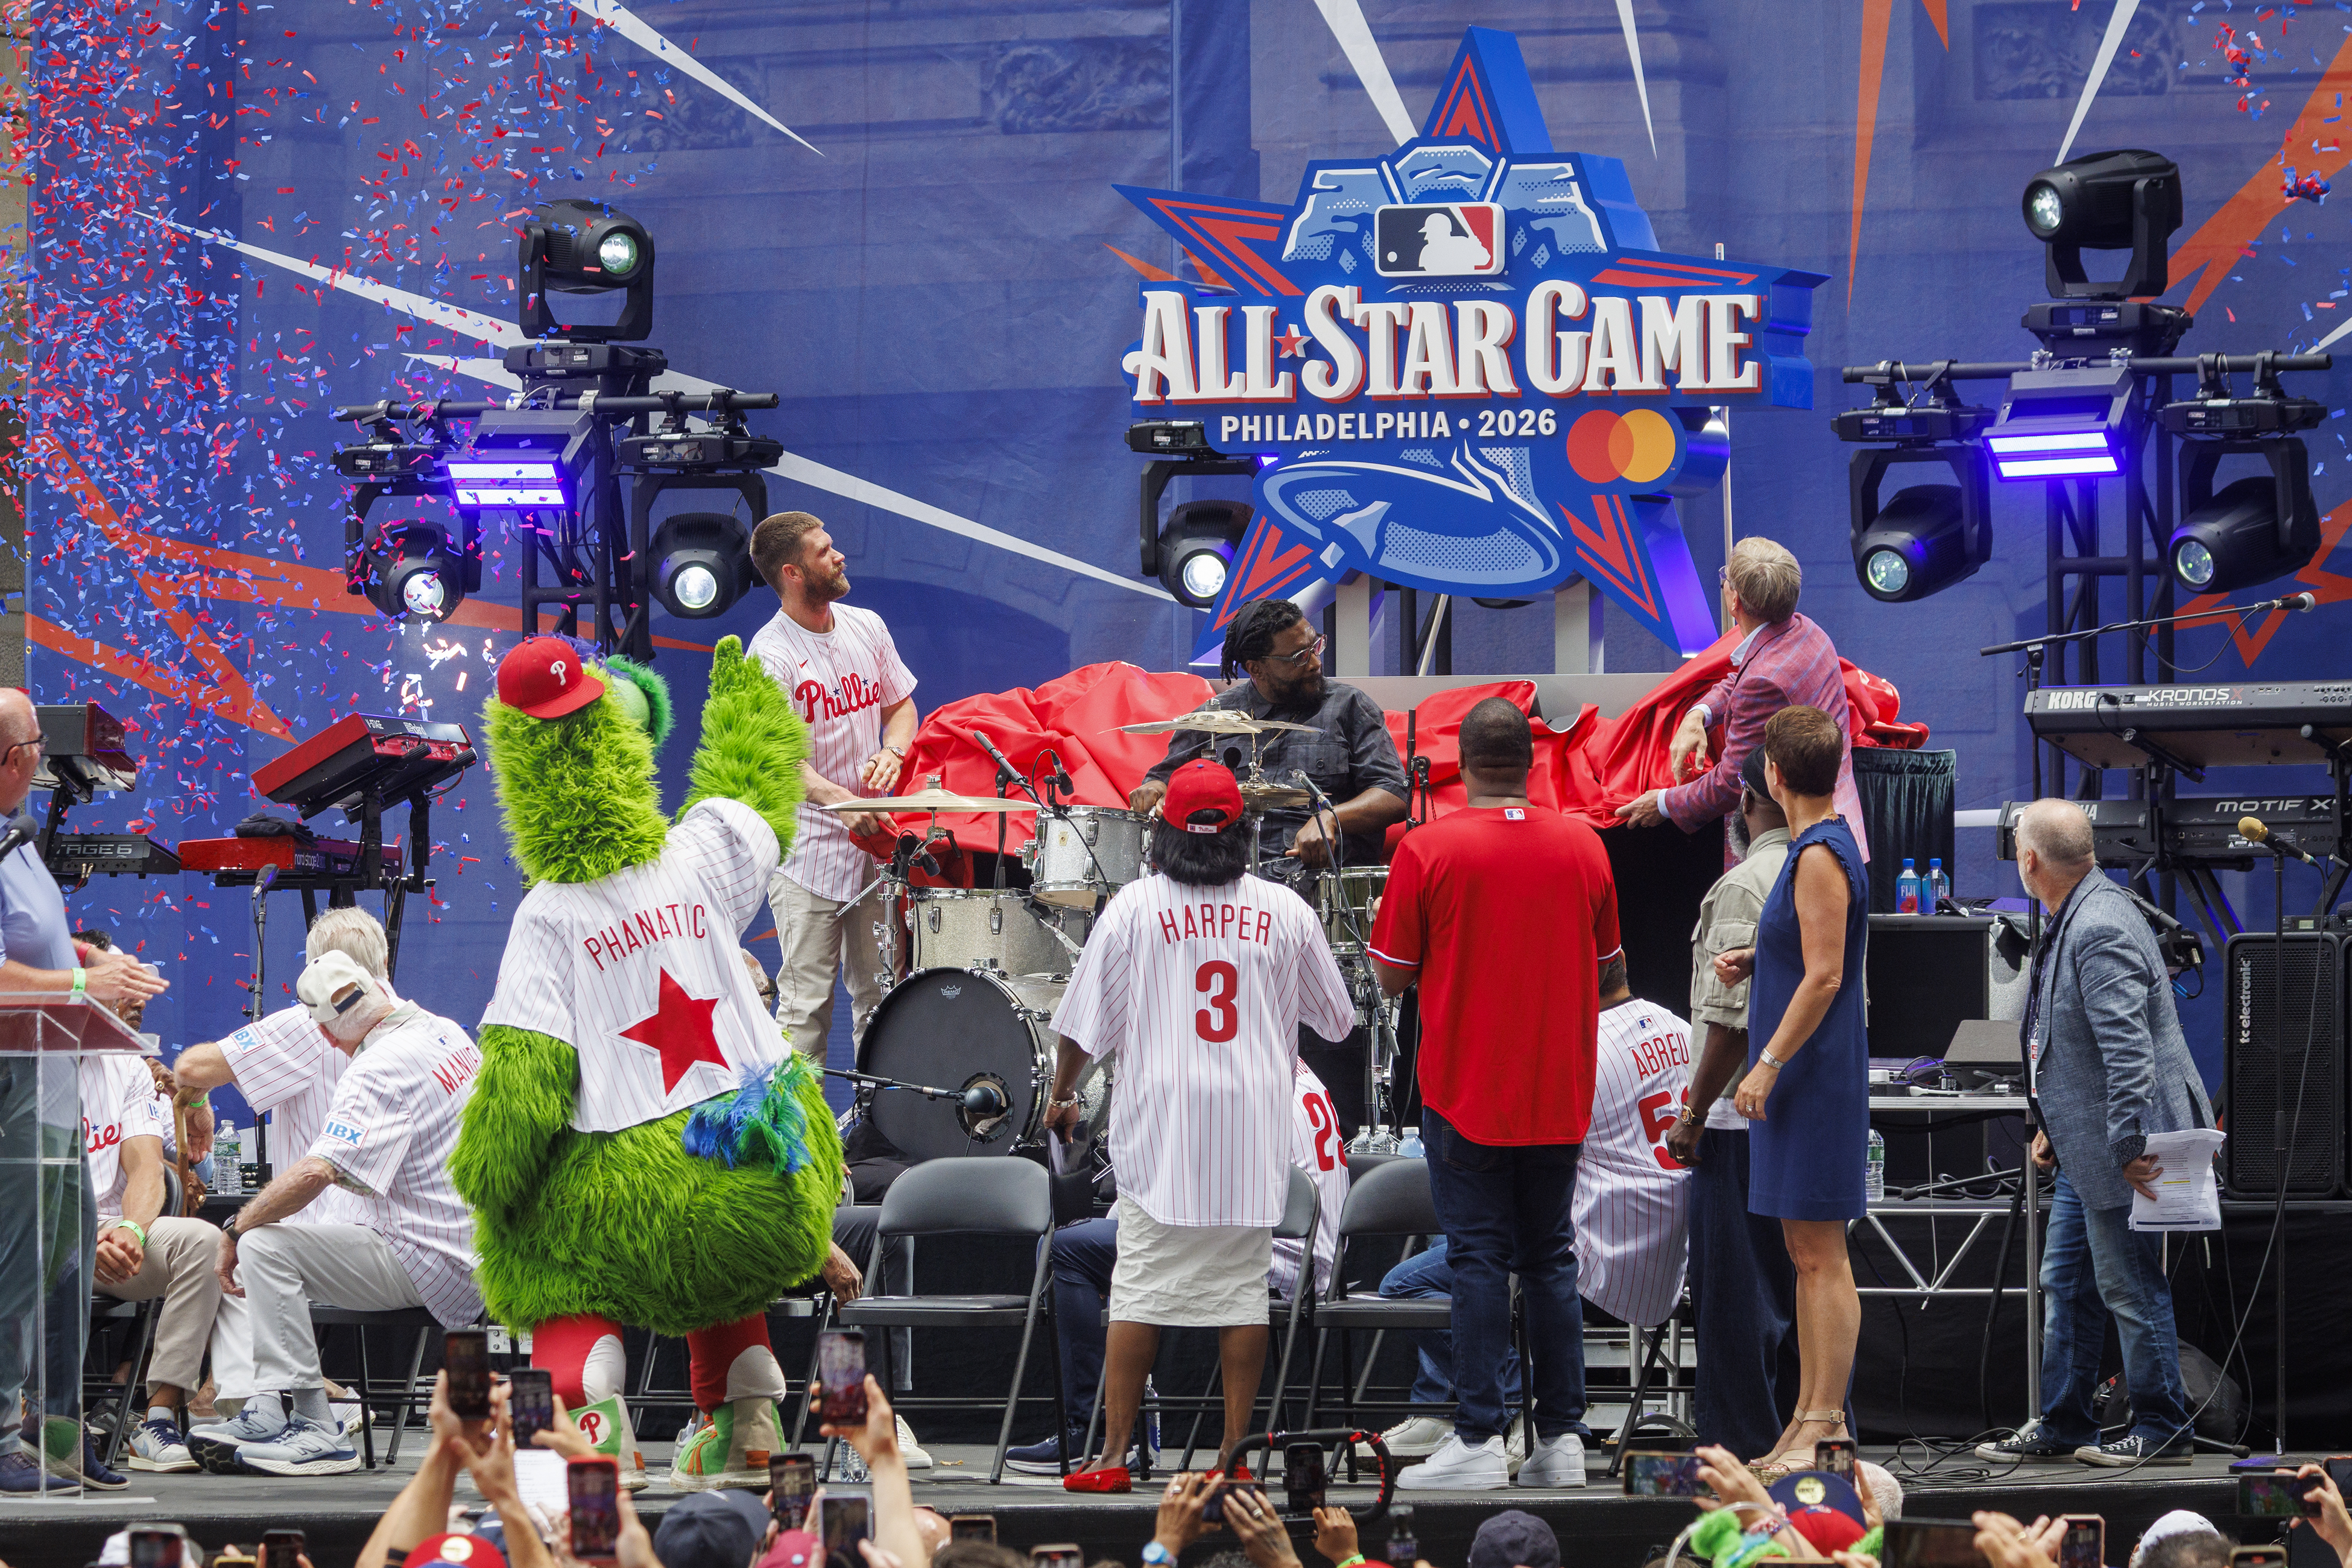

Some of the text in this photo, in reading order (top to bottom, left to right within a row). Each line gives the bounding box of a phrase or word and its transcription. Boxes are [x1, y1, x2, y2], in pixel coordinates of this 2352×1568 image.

[1525, 279, 1762, 399] GAME
[1221, 408, 1557, 443] PHILADELPHIA 2026
[2048, 691, 2097, 709] KORG
[2214, 799, 2305, 812] MOTIF
[1901, 885, 1916, 897] FIJI
[583, 903, 706, 972] PHANATIC
[1157, 903, 1271, 946] HARPER
[1195, 959, 1238, 1043] 3
[2239, 960, 2251, 1044] tc electronic
[232, 1028, 258, 1052] IBX
[1631, 1032, 1689, 1081] ABREU
[325, 1121, 362, 1145] IBX
[1637, 1084, 1689, 1171] 5
[580, 1412, 601, 1445] P
